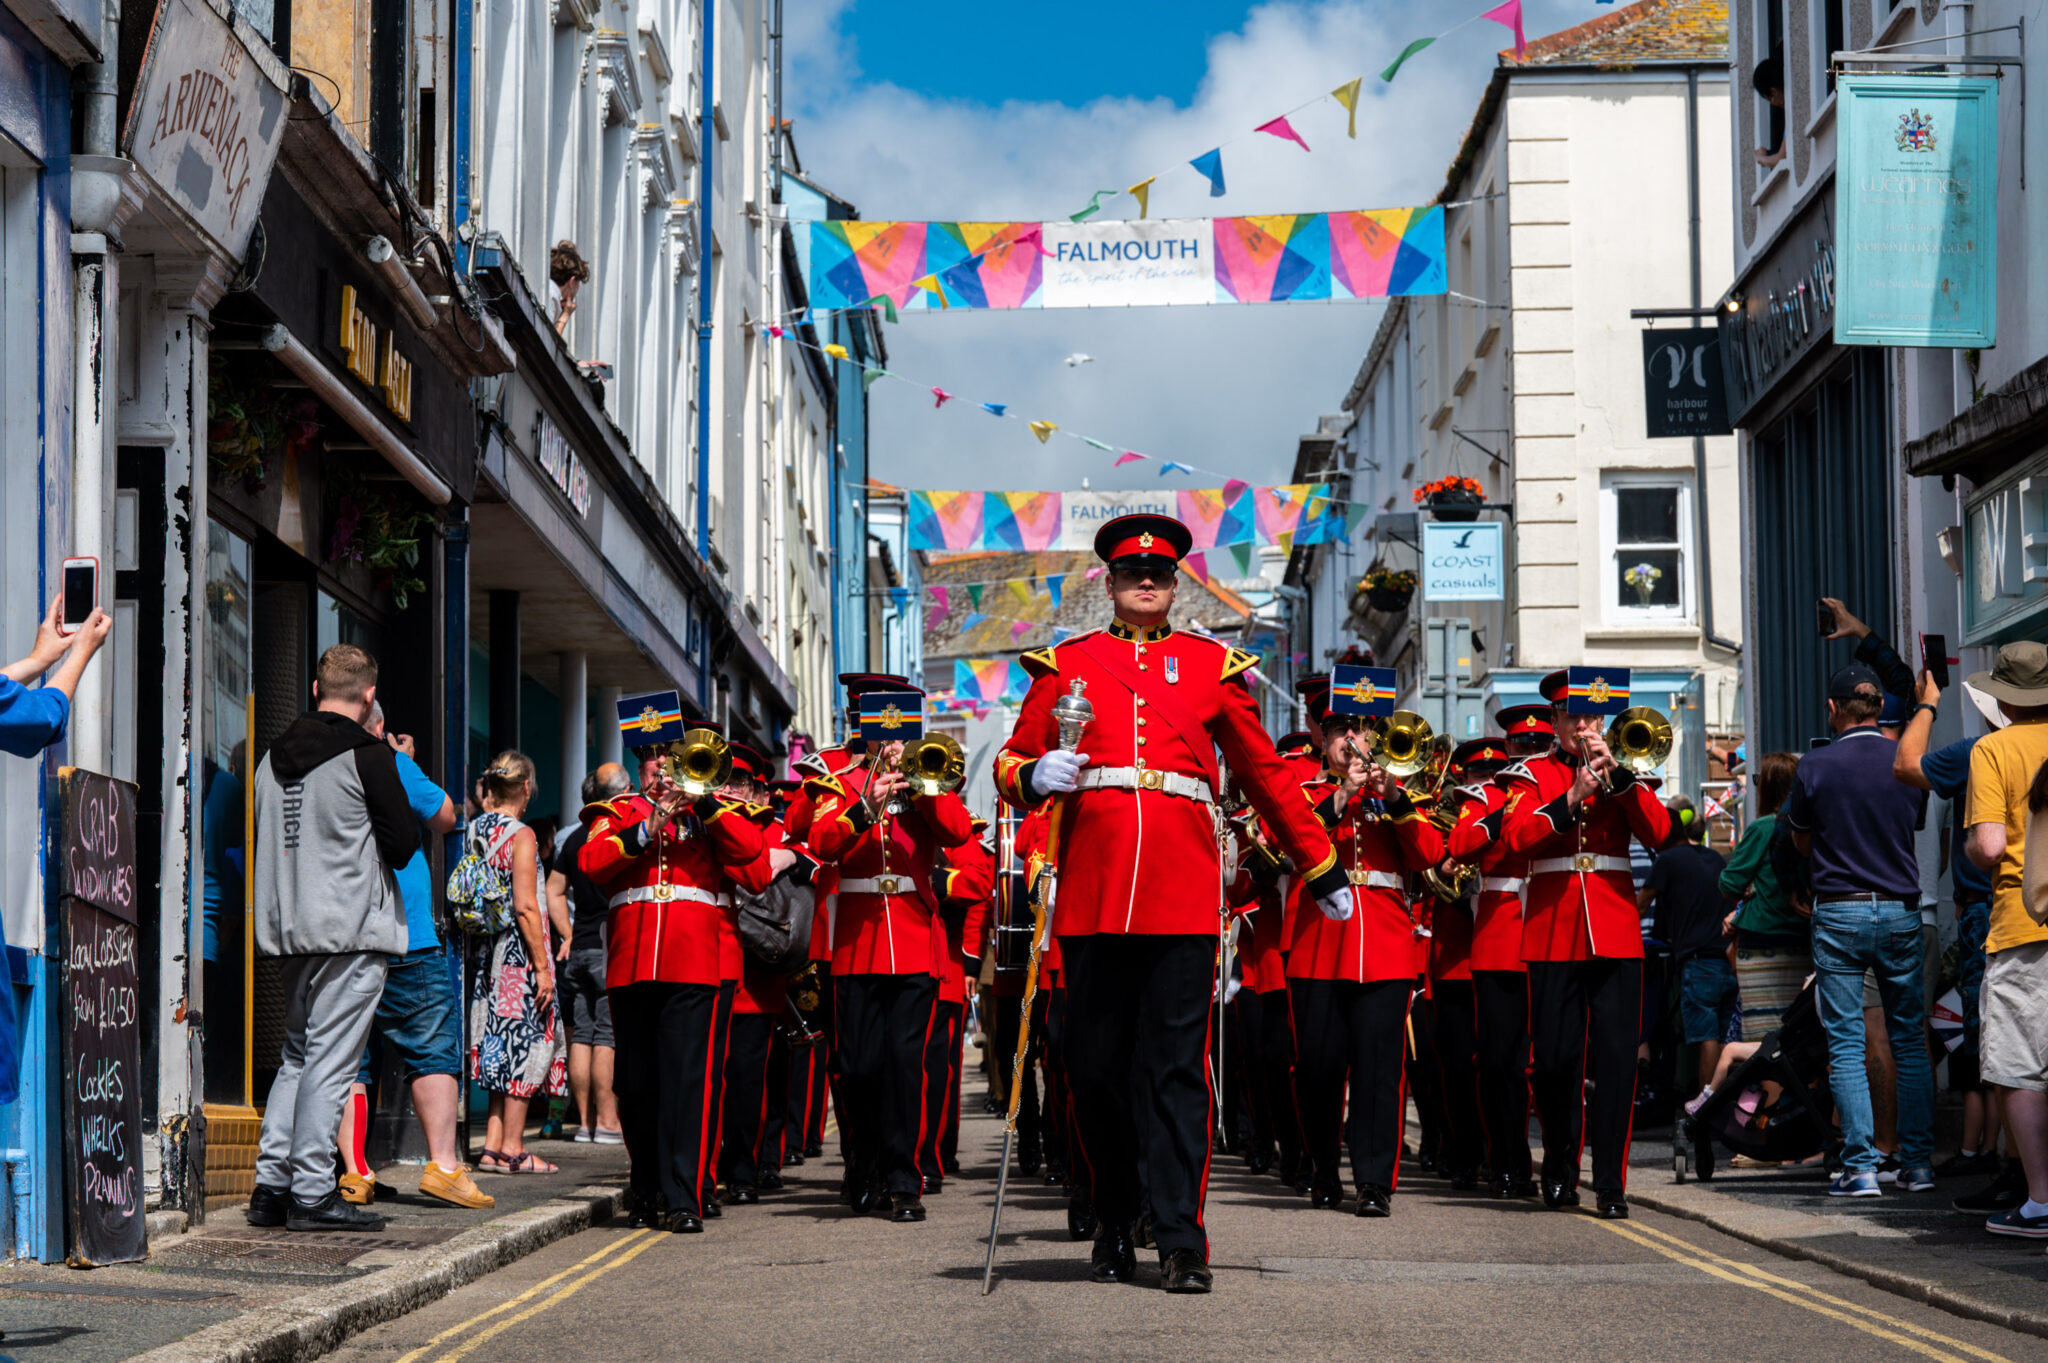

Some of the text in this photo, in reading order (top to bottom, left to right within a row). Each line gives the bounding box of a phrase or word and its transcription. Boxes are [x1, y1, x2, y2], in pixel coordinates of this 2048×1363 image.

[220, 33, 244, 80] THE
[149, 69, 251, 230] ARWENACK
[1861, 176, 1972, 195] wearnes
[1057, 239, 1199, 262] FALMOUTH
[1058, 270, 1081, 285] the
[1088, 268, 1125, 286] spirit
[1144, 266, 1169, 280] the
[1173, 268, 1199, 277] sea
[1810, 240, 1836, 320] vie
[1666, 398, 1709, 409] harbour
[1667, 410, 1708, 422] view
[1071, 503, 1167, 519] FALMOUTH
[1432, 555, 1495, 569] COAST
[1431, 572, 1496, 589] casuals
[79, 773, 120, 860] CRAB
[81, 1113, 125, 1162] WHELKS
[84, 1161, 137, 1217] PRAWNS
